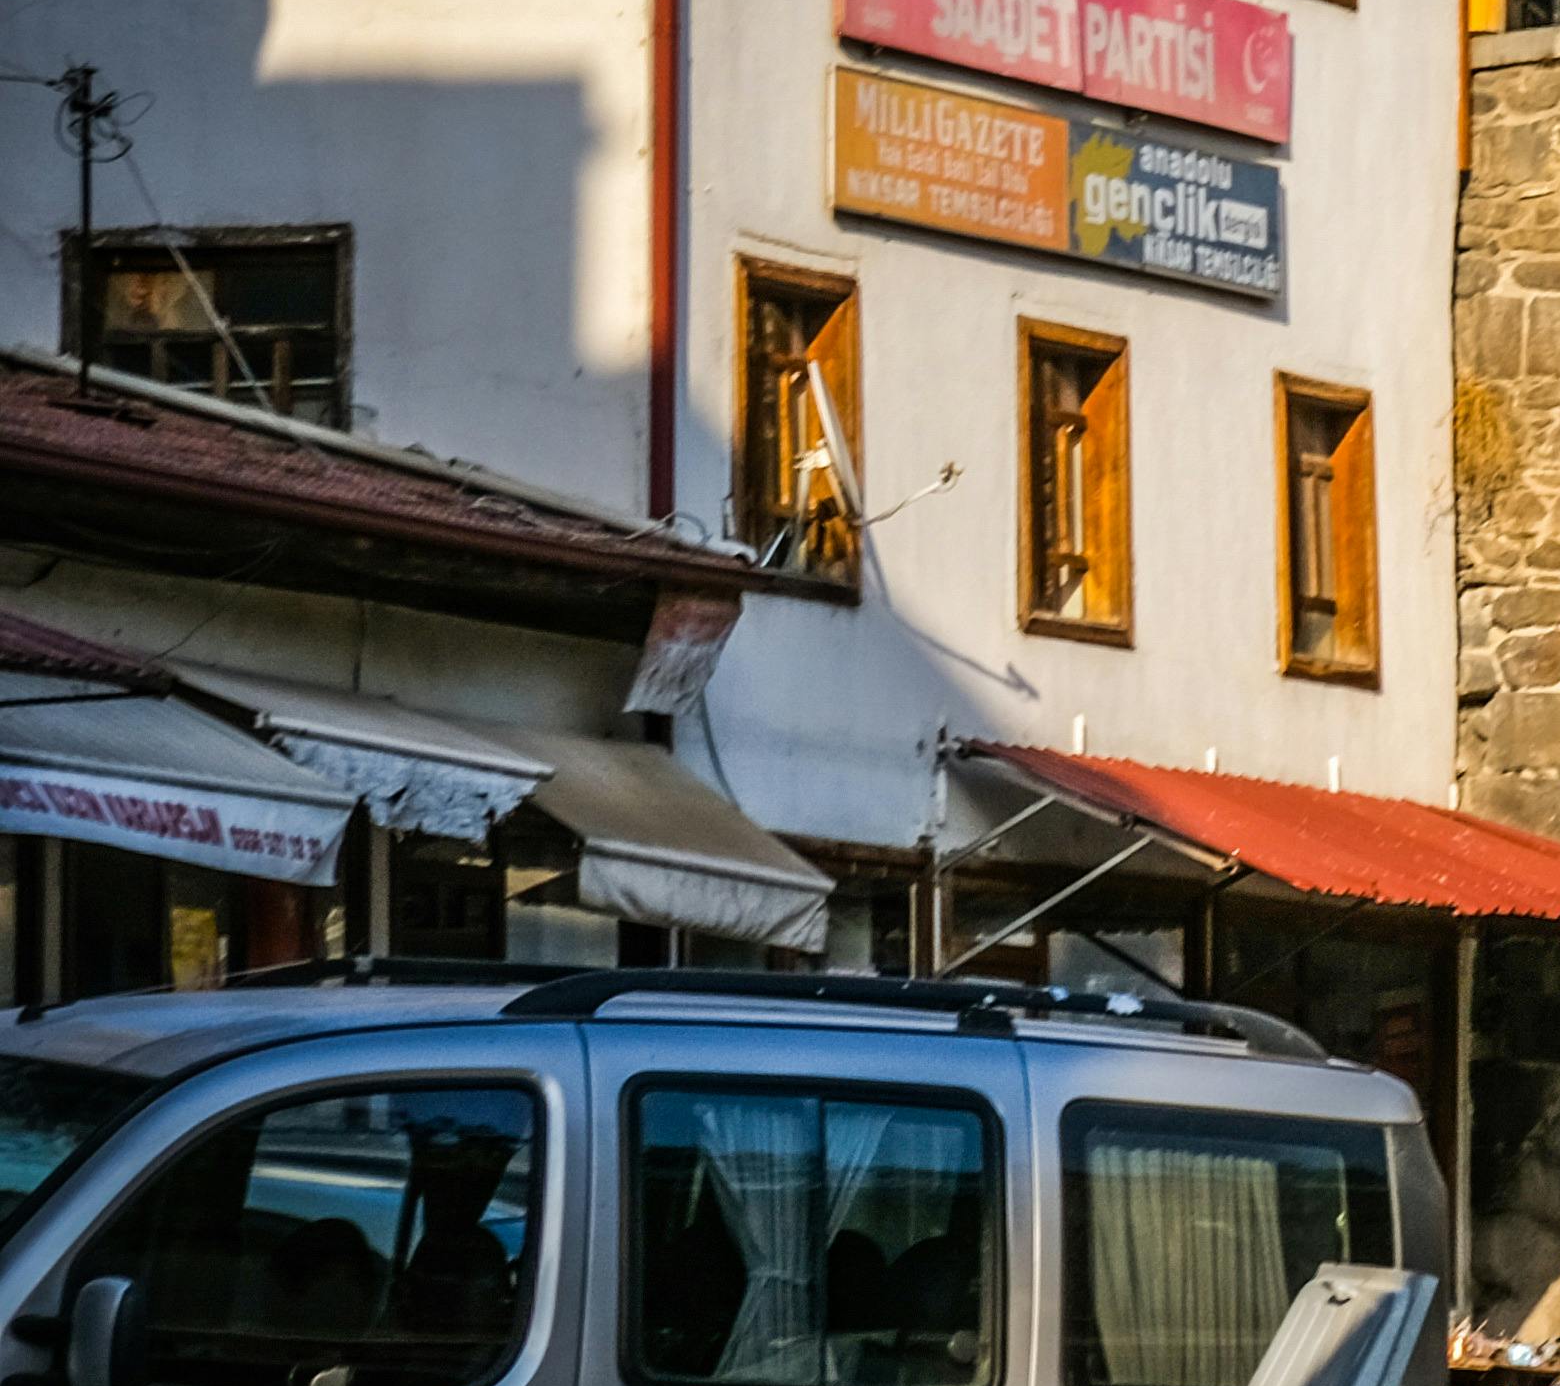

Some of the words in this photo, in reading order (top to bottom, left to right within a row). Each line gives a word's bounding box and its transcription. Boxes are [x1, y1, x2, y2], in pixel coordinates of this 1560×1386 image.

[1085, 2, 1216, 102] PARTİSİ
[1139, 143, 1233, 191] anadolu
[1084, 173, 1218, 243] gençlik
